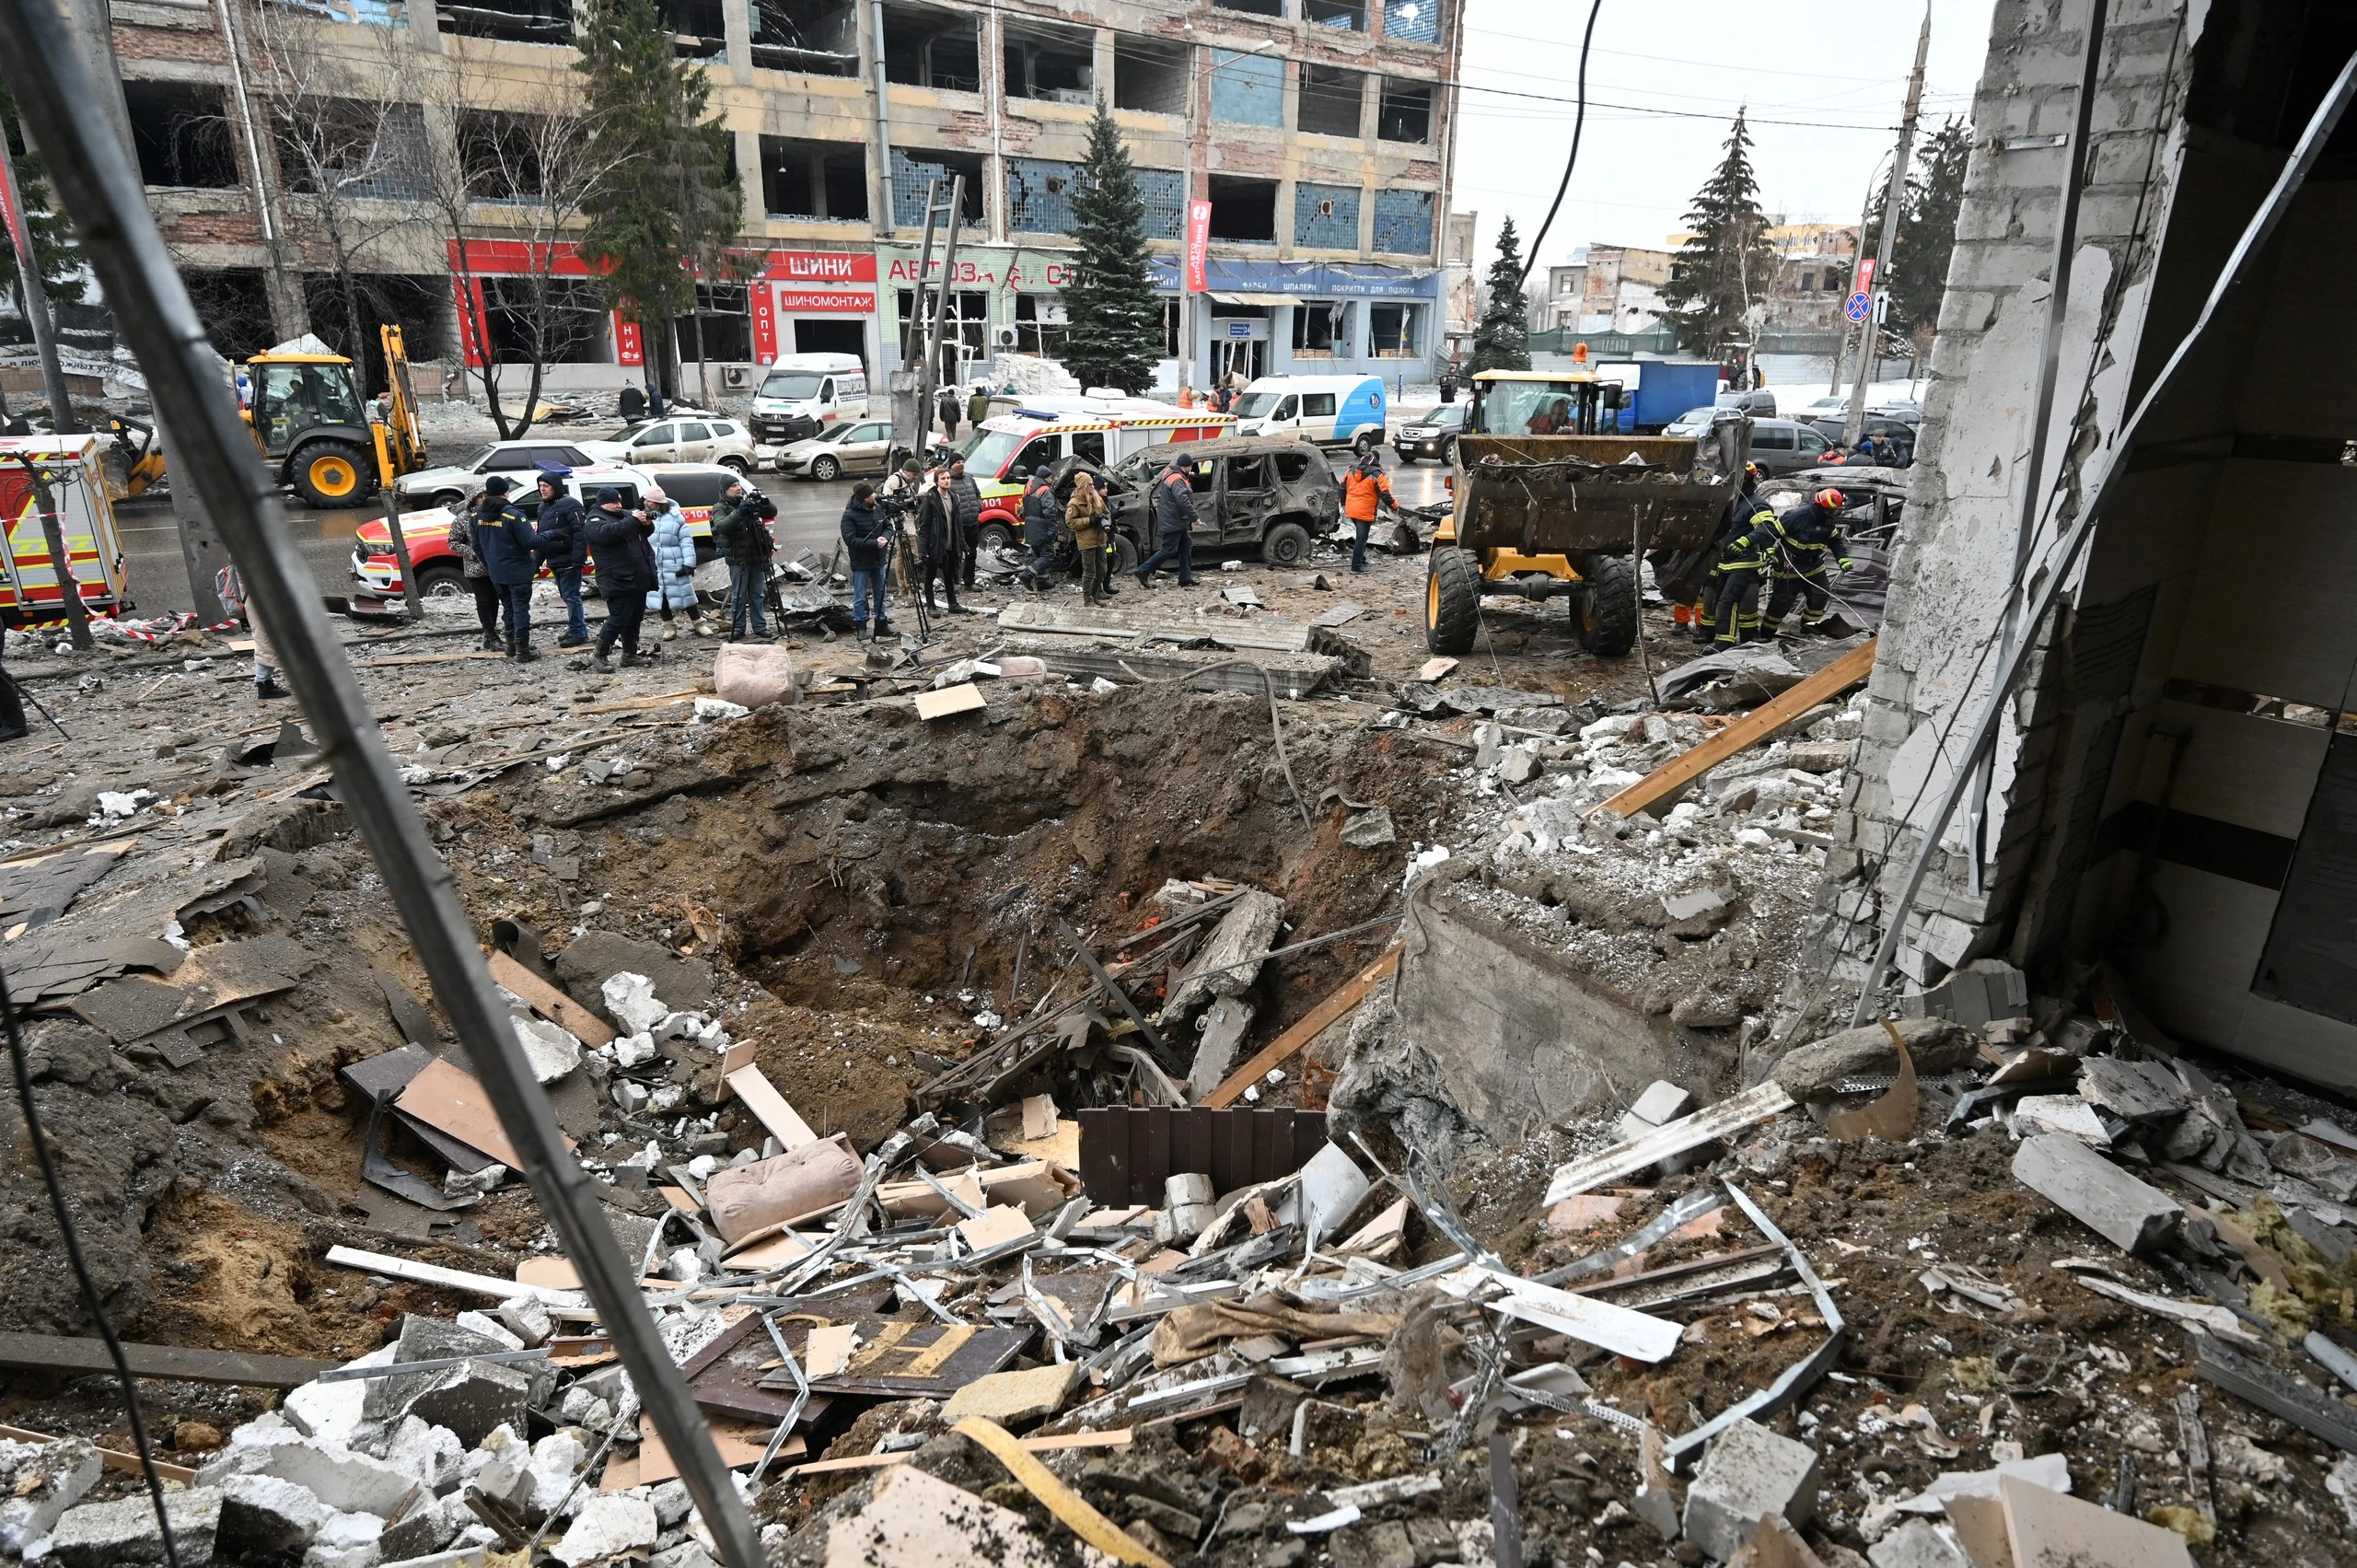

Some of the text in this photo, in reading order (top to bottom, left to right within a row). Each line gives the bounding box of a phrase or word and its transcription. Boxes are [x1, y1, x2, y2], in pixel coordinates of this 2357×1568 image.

[790, 257, 852, 276] ШИНИ
[1283, 283, 1317, 291] ШПАЛЕРИ
[784, 296, 872, 308] ШИНОМОНТАЖ
[759, 307, 769, 343] ОПТ
[59, 360, 93, 370] ожных
[982, 497, 1002, 507] 101
